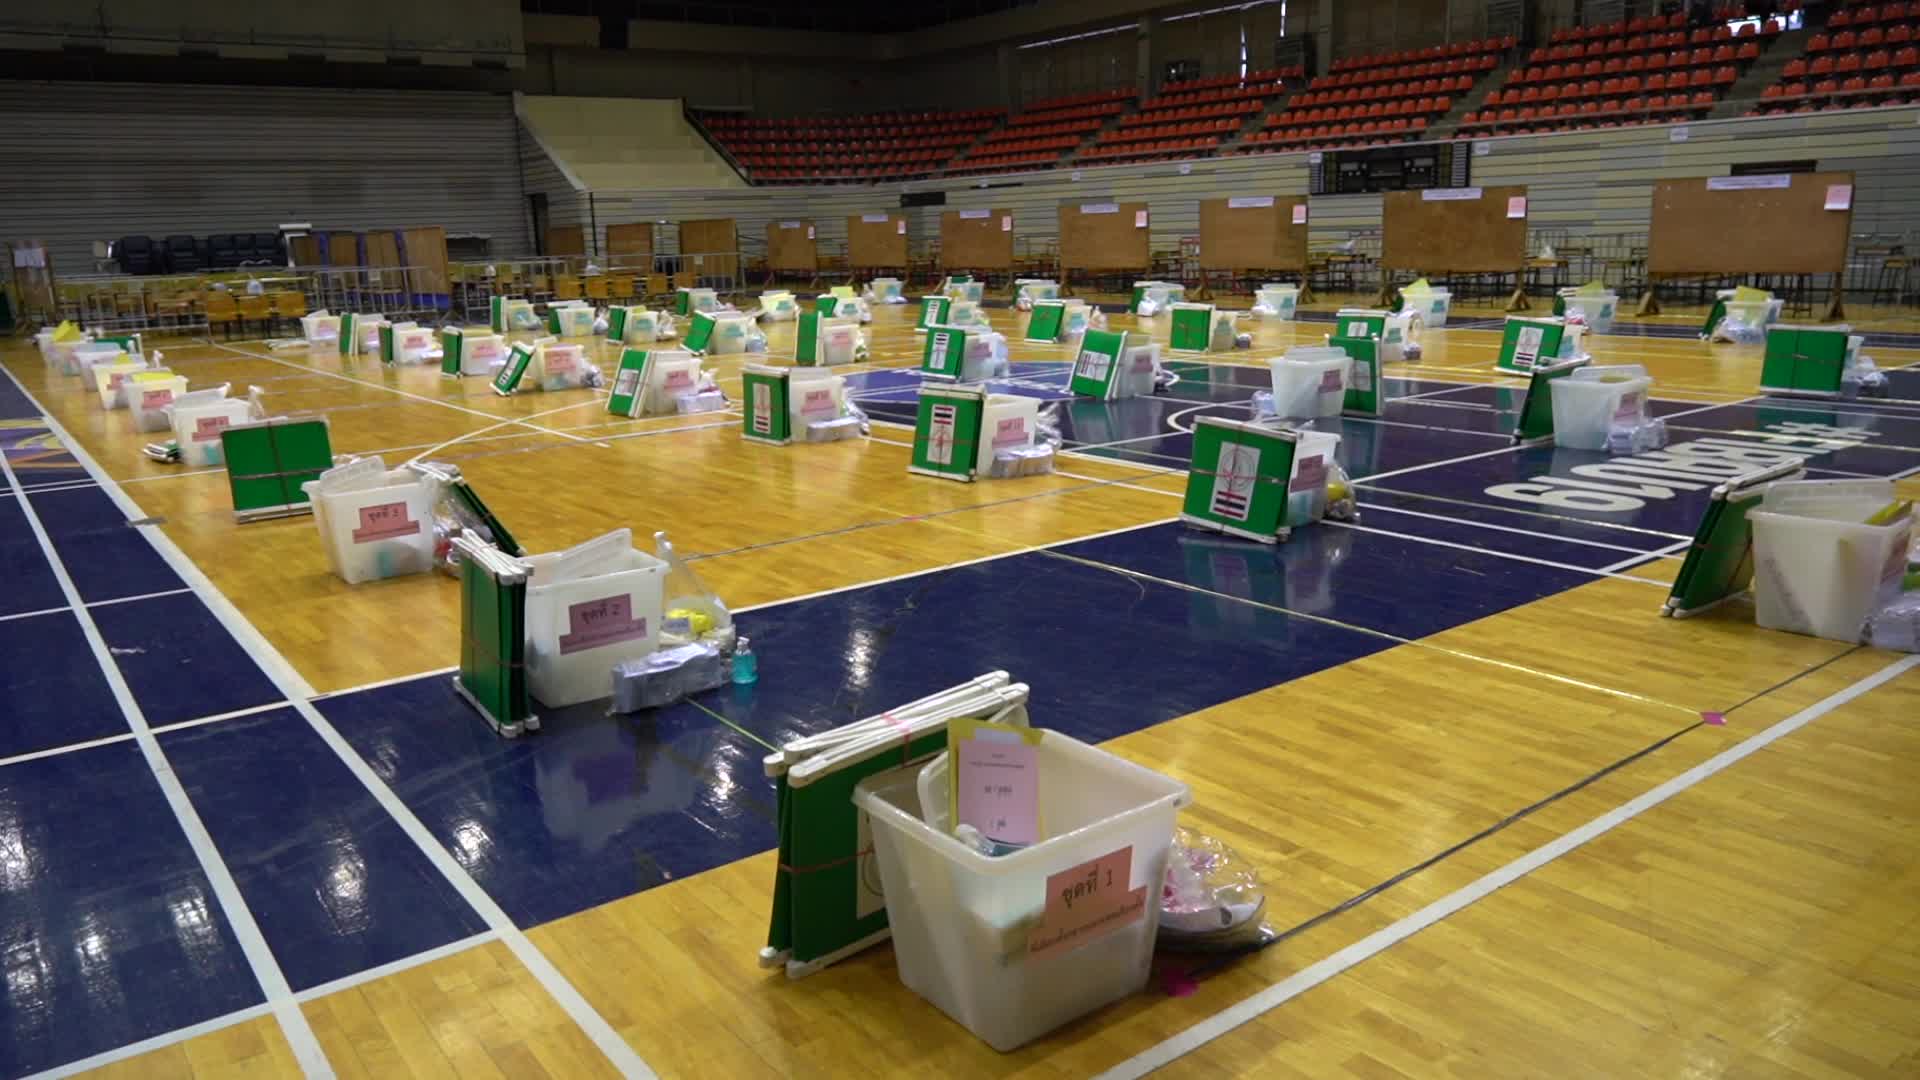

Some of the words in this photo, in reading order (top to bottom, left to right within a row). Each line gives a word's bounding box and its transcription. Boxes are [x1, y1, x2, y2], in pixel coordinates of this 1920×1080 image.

[1062, 864, 1098, 910] ชุดที่
[1105, 868, 1113, 887] 1
